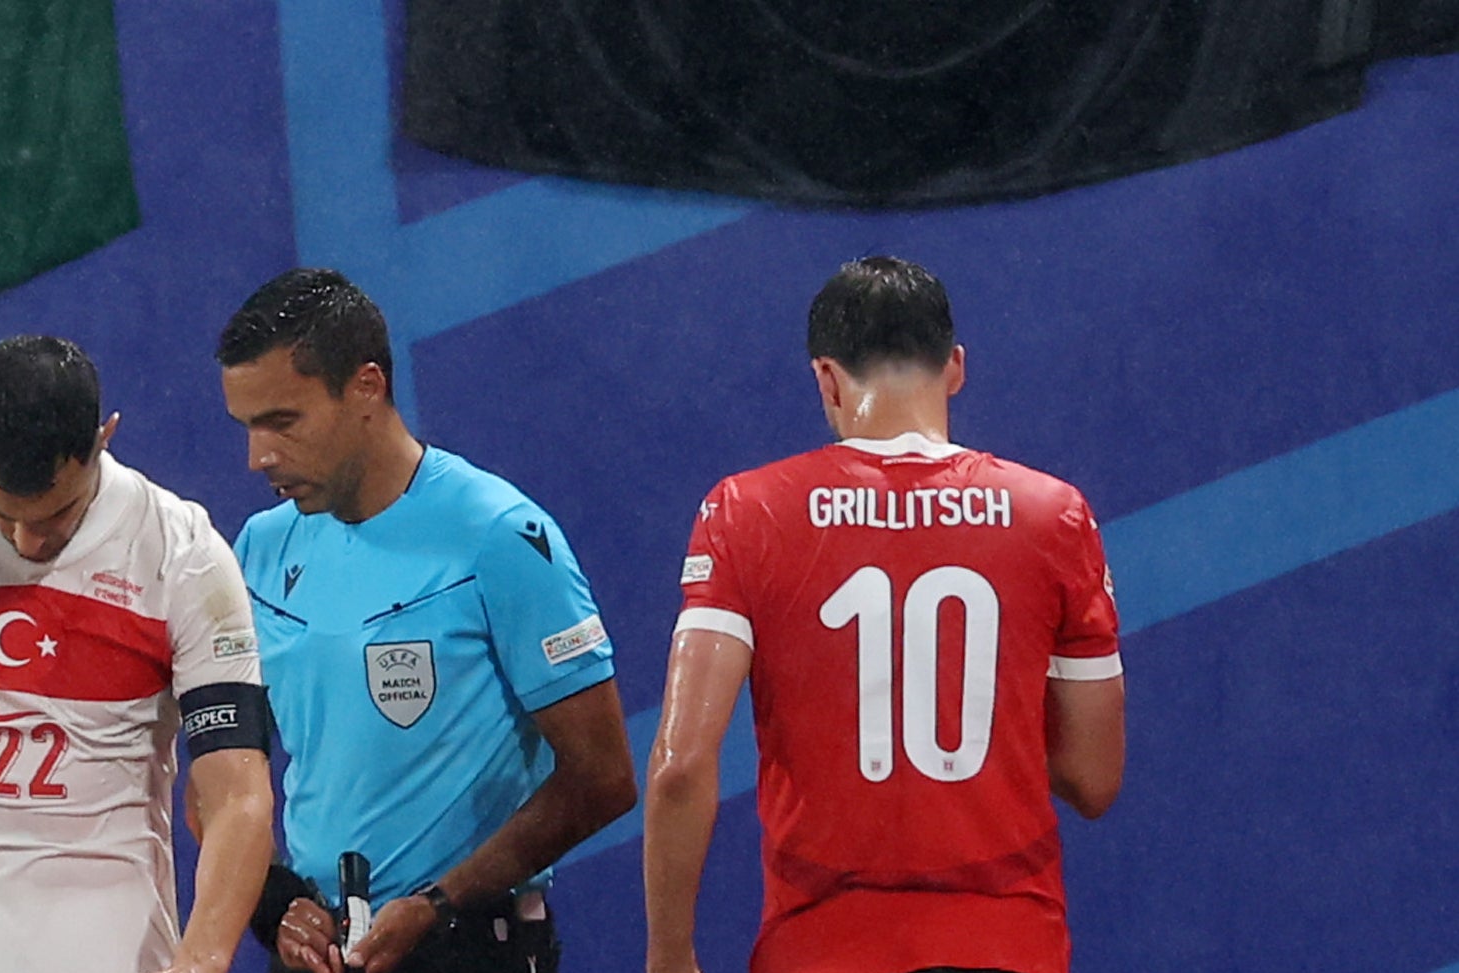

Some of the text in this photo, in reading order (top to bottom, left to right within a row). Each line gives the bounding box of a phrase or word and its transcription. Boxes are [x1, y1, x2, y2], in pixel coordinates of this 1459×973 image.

[808, 486, 1011, 529] GRILLITSCH
[379, 652, 417, 668] UEFA
[382, 677, 420, 688] MATCH
[818, 565, 1000, 782] 10
[378, 690, 428, 702] OFFICIAL
[185, 709, 237, 732] ESPECT
